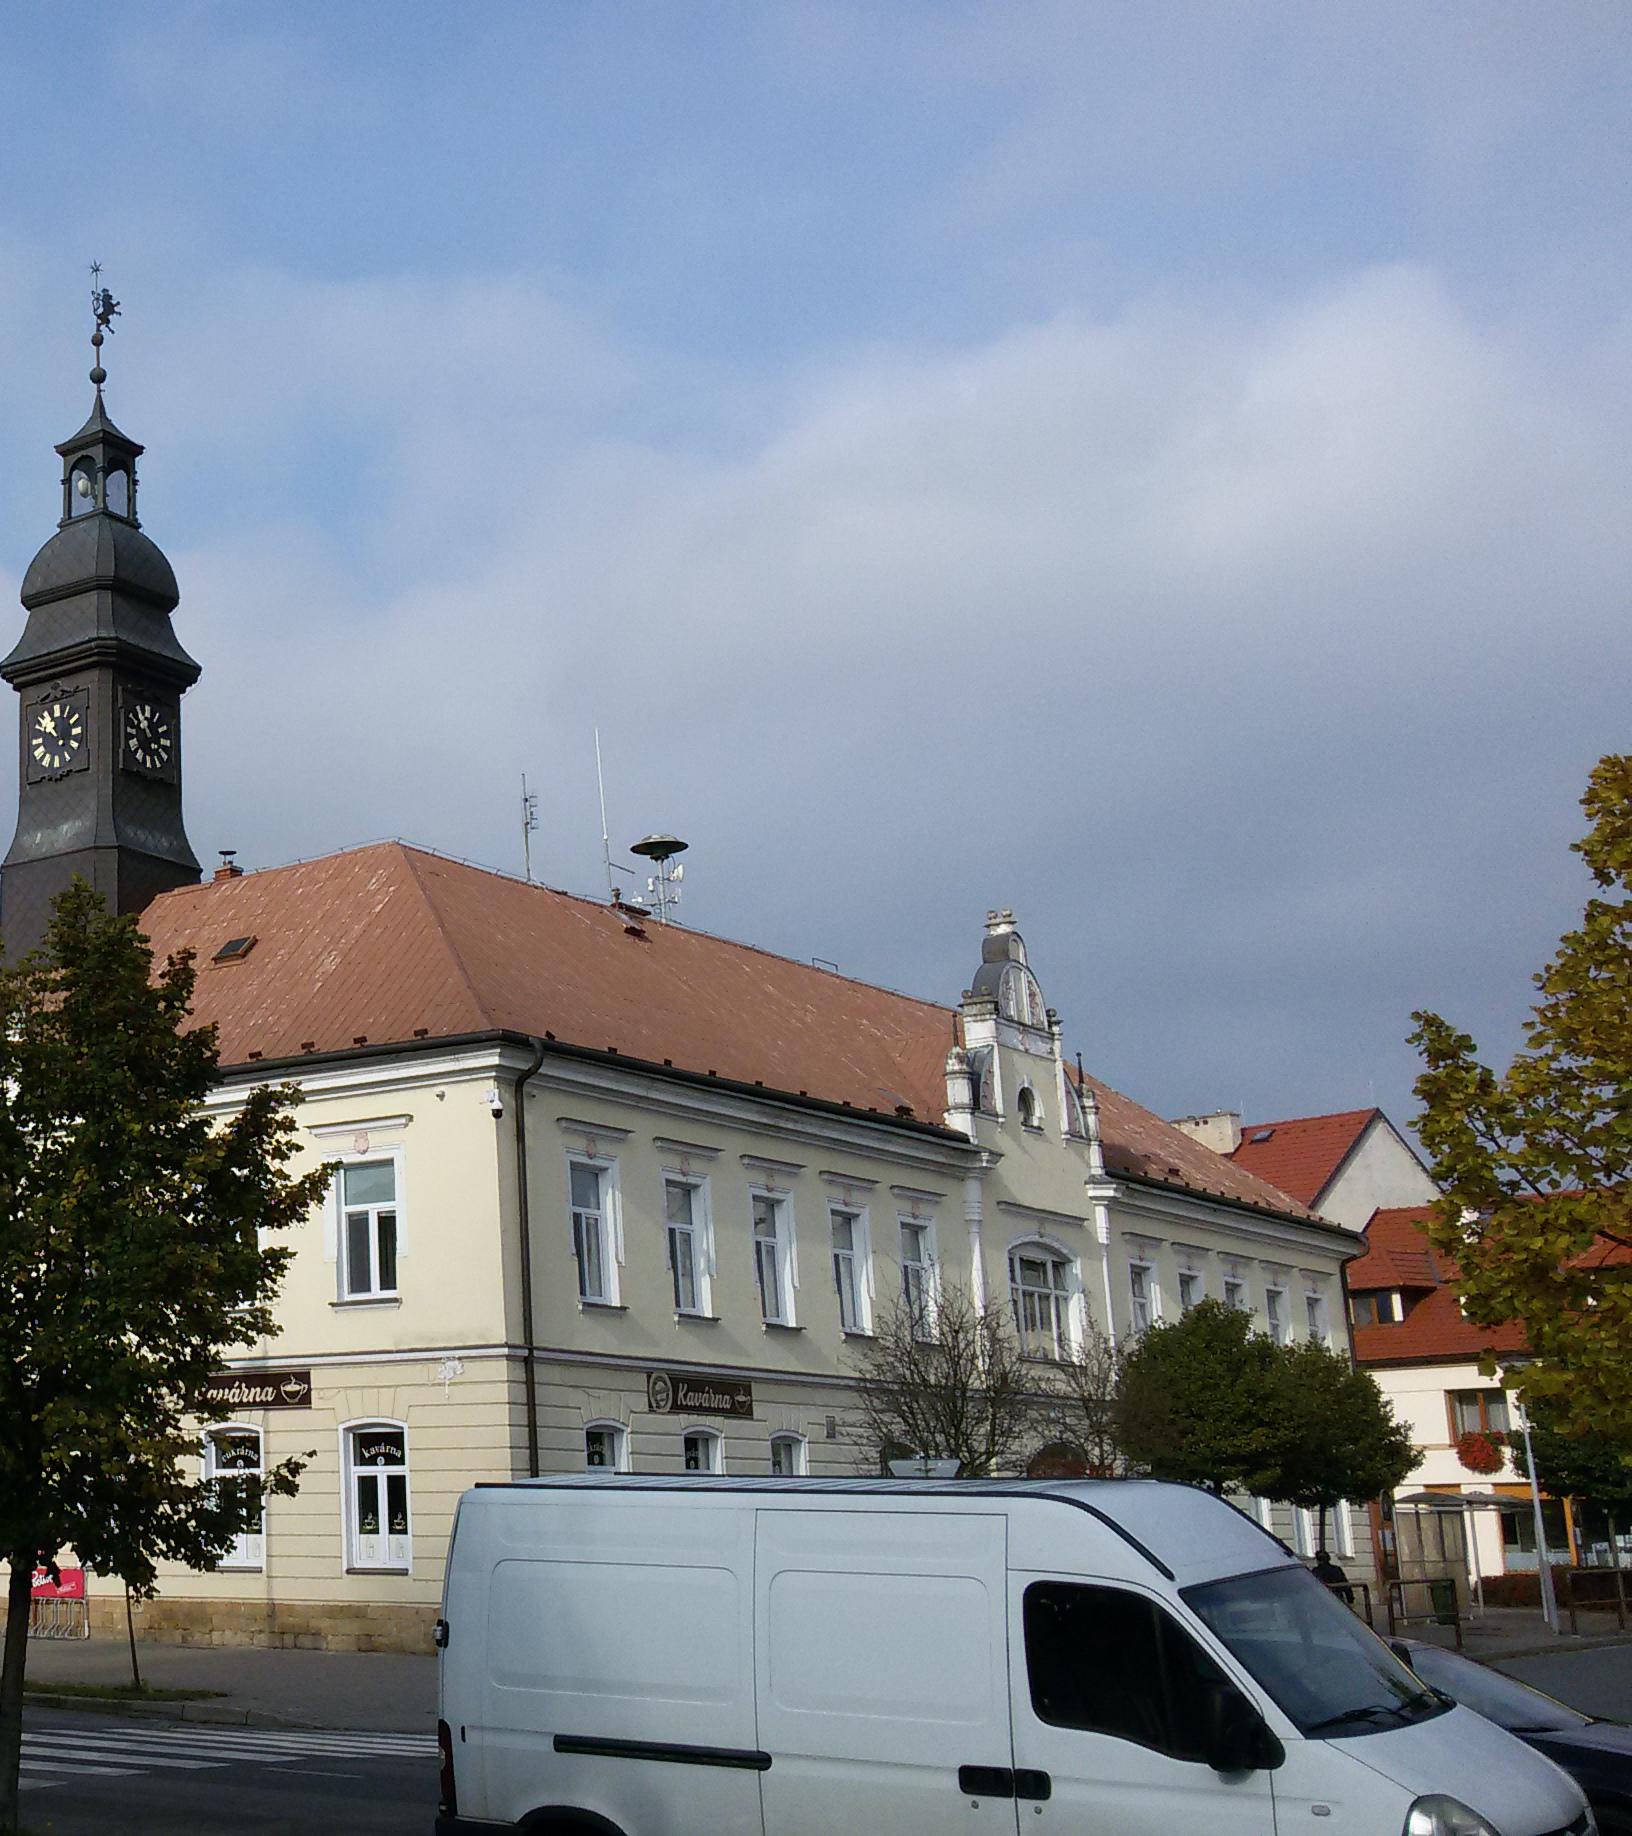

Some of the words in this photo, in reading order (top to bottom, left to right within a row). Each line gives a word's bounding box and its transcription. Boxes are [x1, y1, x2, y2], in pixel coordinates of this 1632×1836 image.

[194, 1381, 276, 1404] avárna
[677, 1383, 733, 1409] Kavárna
[222, 1446, 259, 1462] cukrárna
[361, 1442, 402, 1459] kavárna
